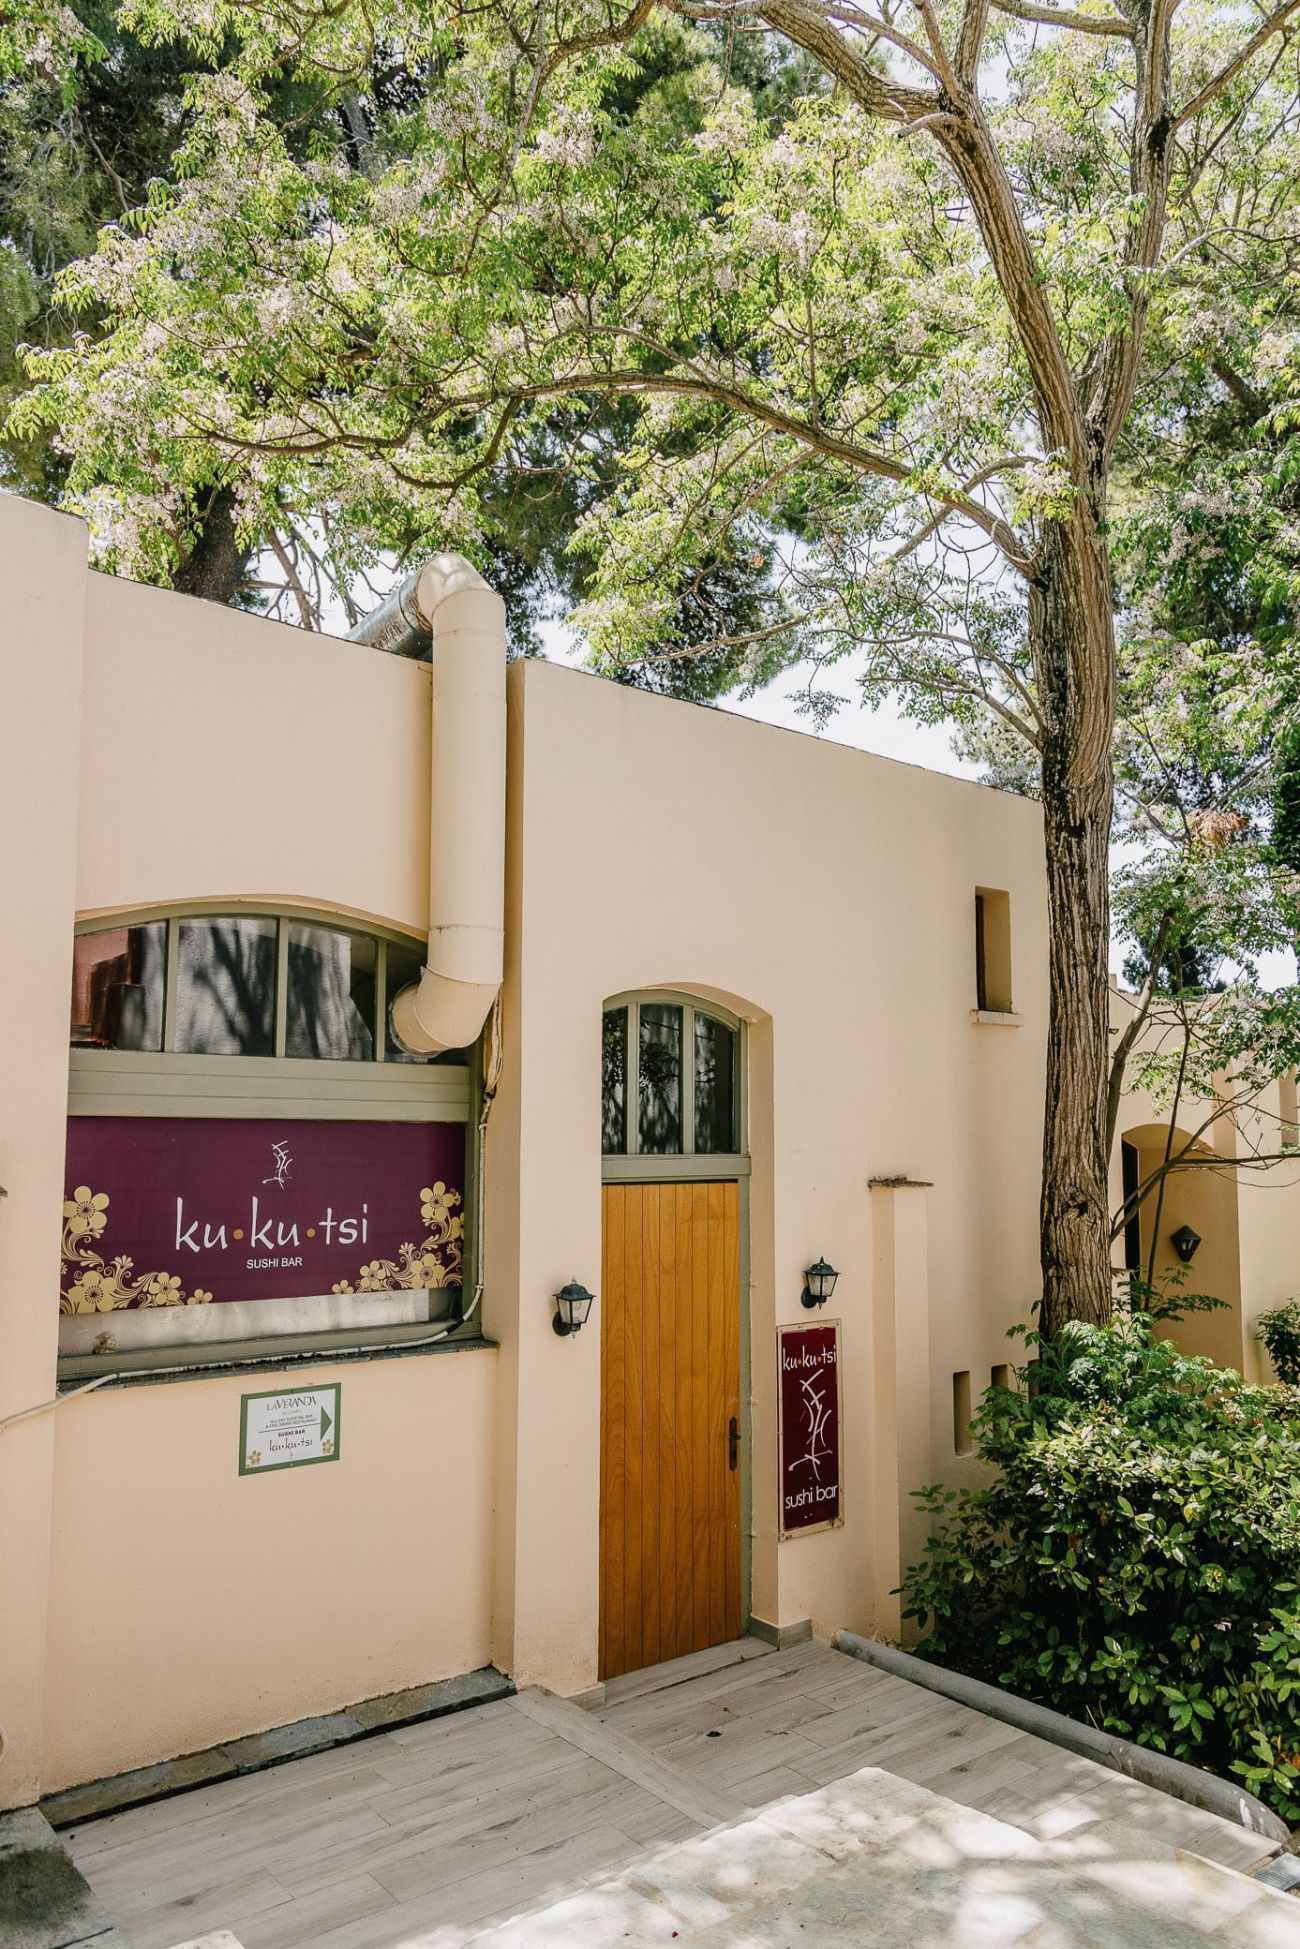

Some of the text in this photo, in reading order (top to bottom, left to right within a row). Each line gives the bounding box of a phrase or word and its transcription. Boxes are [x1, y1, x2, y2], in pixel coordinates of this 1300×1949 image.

[246, 1256, 303, 1270] SUSHI BAR
[785, 1484, 839, 1510] sushi bar
